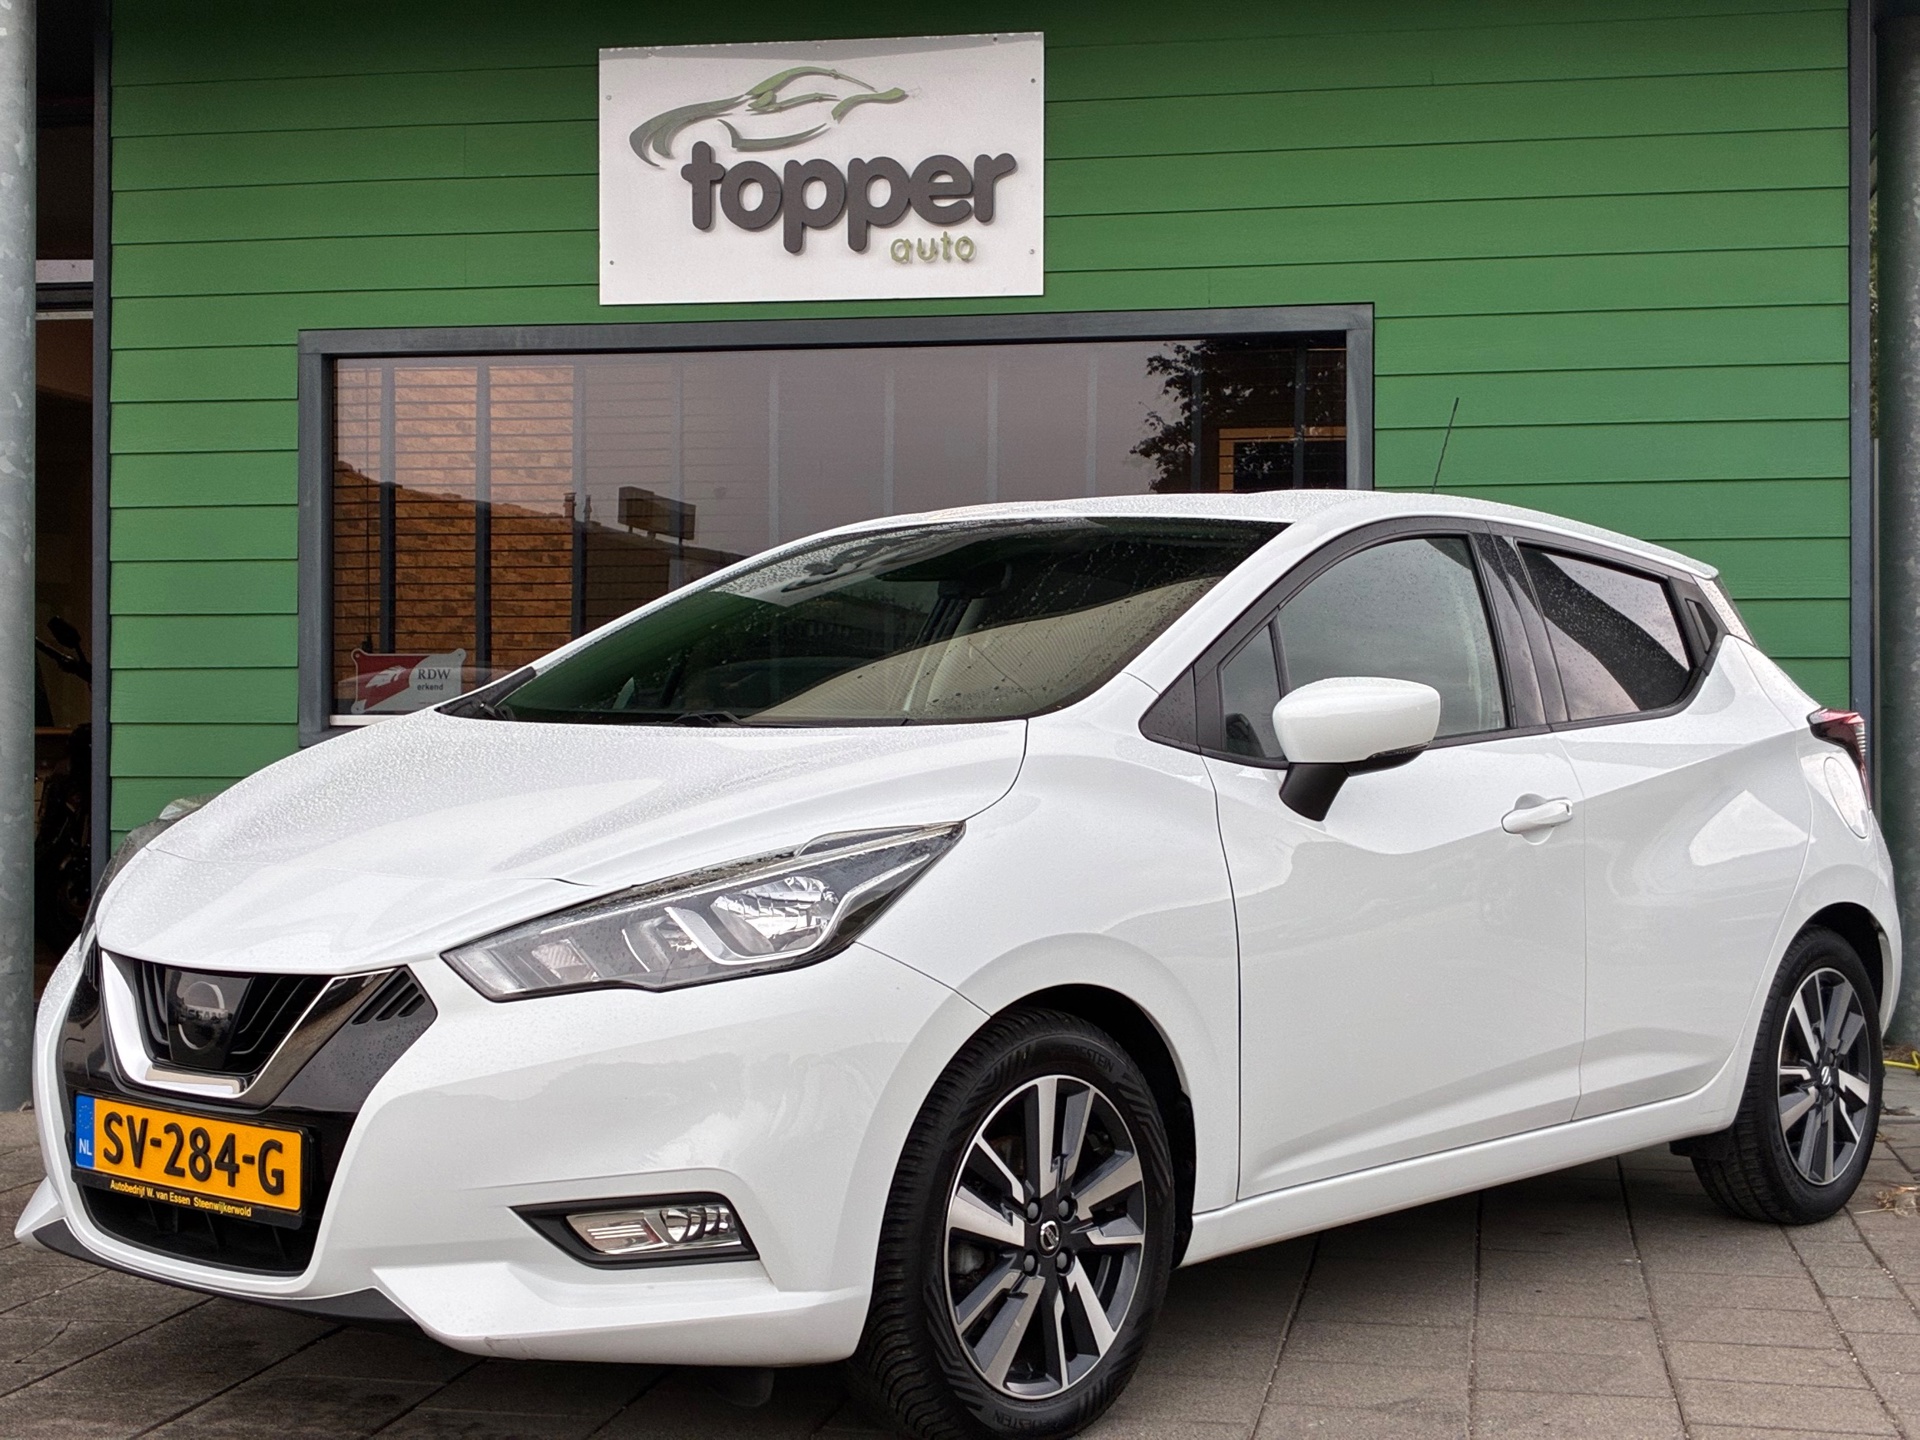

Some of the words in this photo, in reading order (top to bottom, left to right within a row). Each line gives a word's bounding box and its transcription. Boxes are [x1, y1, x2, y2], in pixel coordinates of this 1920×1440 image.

[681, 140, 1018, 254] topper
[890, 231, 976, 264] auto
[416, 682, 444, 691] erkend
[417, 668, 451, 680] RDW
[78, 1137, 93, 1157] NL
[102, 1111, 285, 1196] SV-284-G
[110, 1179, 145, 1198] Autobedrijf
[146, 1187, 155, 1198] W.
[156, 1191, 169, 1201] van
[169, 1192, 191, 1206] Essen
